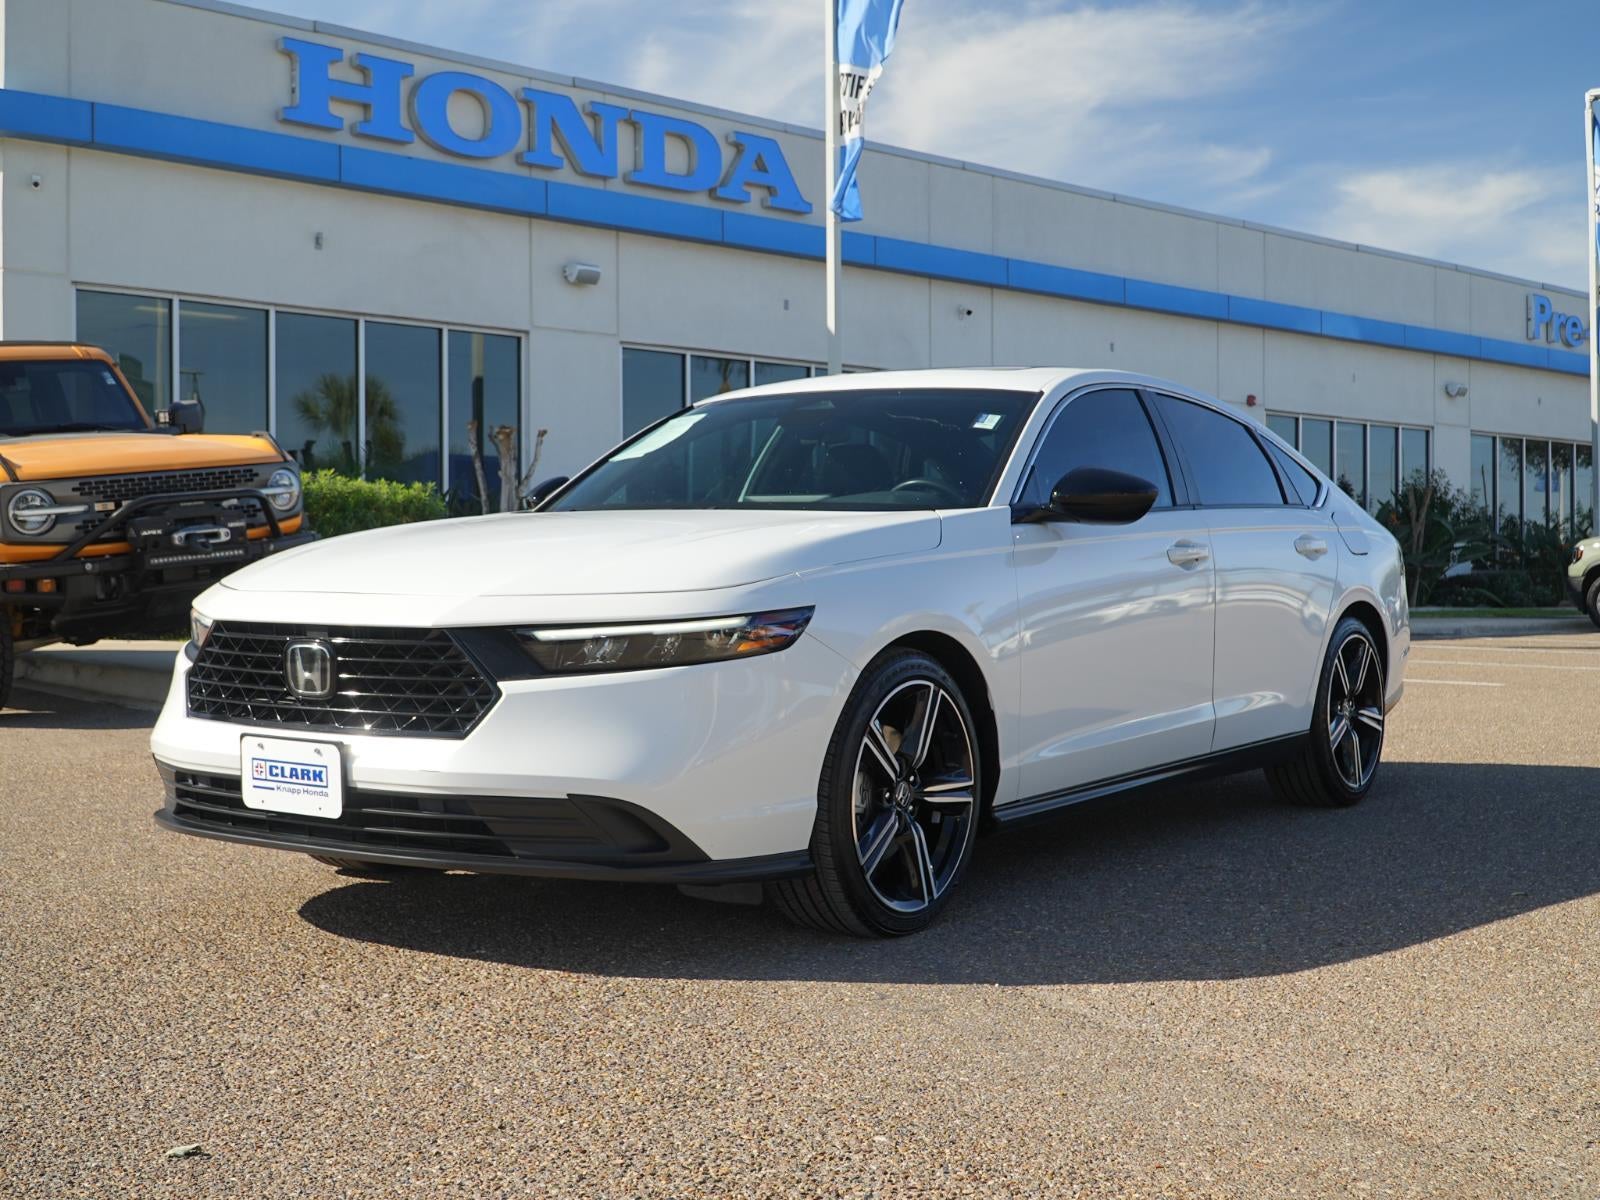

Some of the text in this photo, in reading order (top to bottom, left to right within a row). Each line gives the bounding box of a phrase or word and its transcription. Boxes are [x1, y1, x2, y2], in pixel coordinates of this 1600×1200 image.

[278, 37, 812, 213] HONDA
[268, 764, 324, 783] CLARK
[276, 784, 329, 798] Knapp Honda
